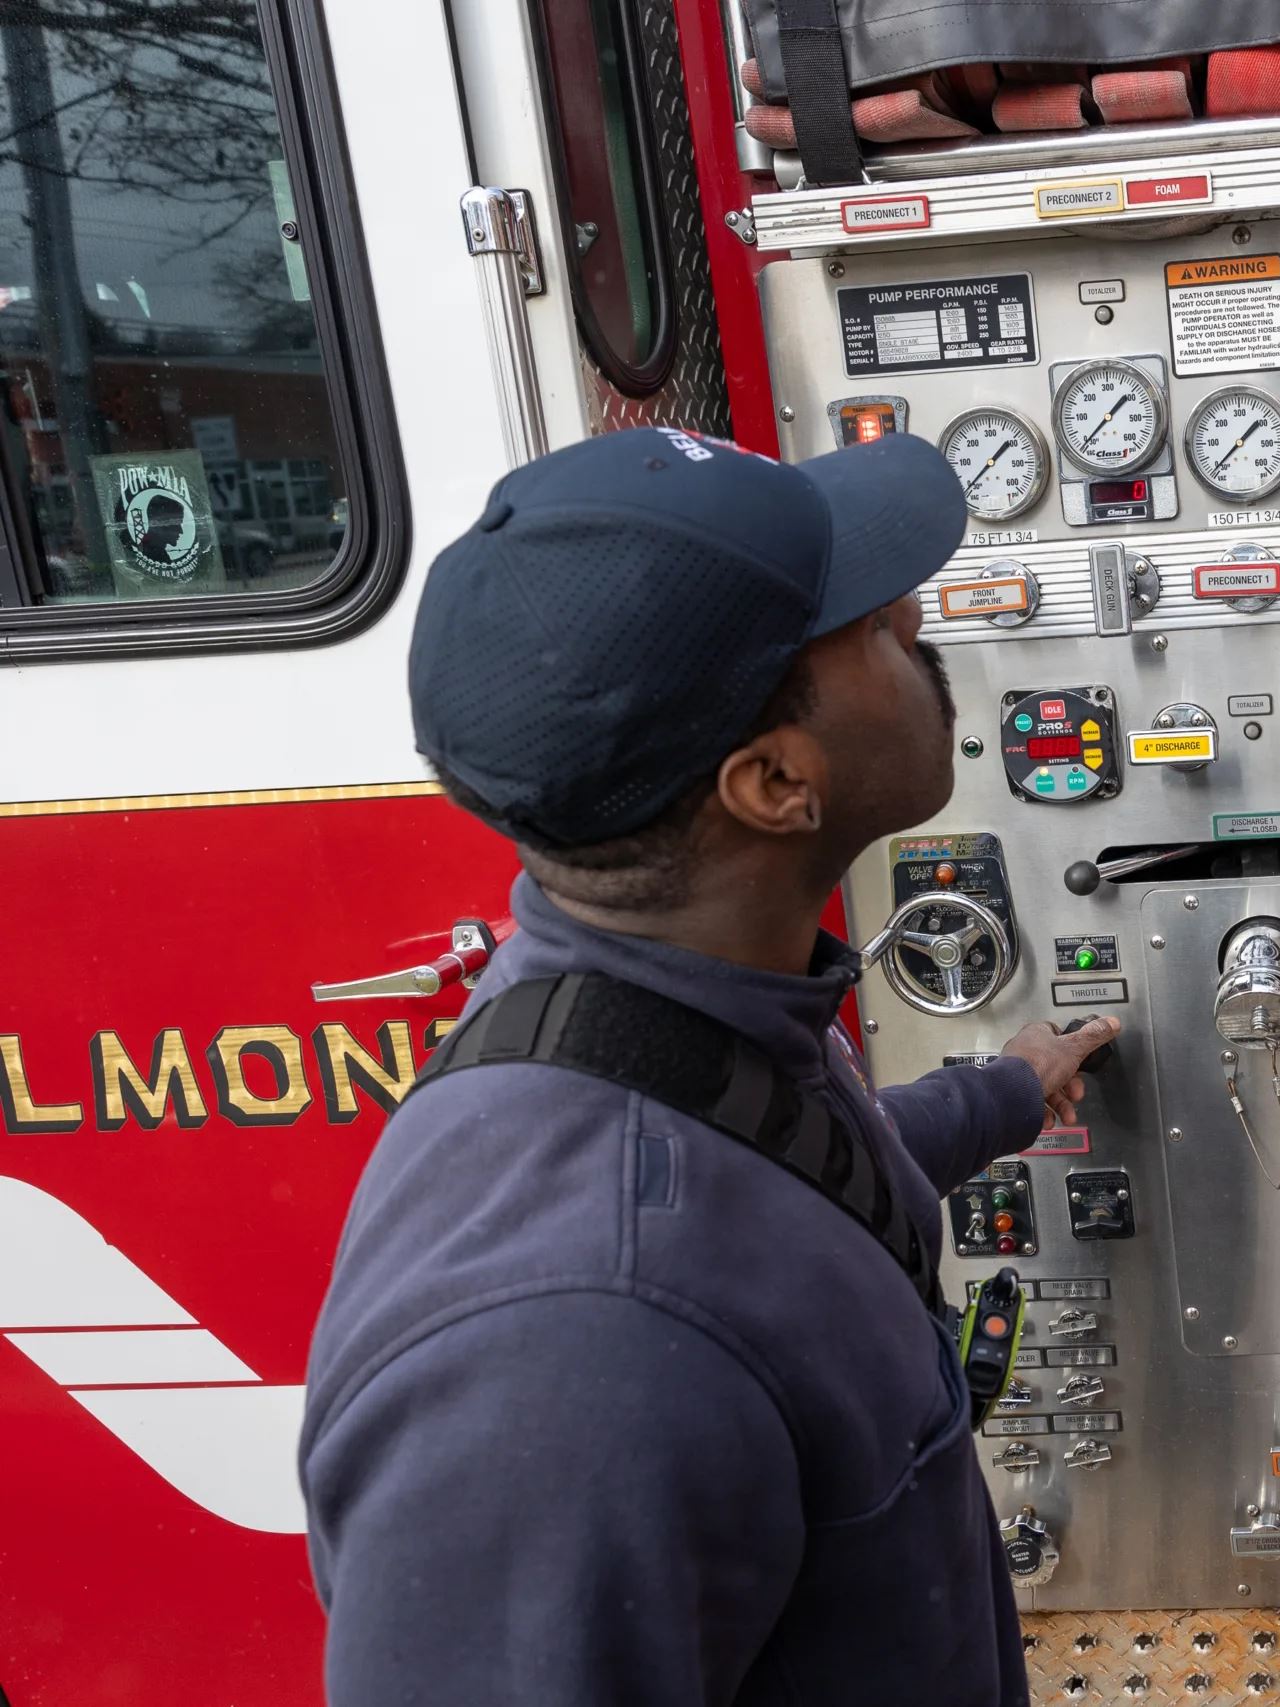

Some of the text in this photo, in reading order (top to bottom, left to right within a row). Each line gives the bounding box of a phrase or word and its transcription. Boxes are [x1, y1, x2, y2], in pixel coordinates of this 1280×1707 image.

[1155, 183, 1180, 196] FOAM
[1046, 191, 1112, 207] PRECONNECT 2
[854, 207, 917, 221] PRECONNECT 1
[1195, 262, 1267, 278] WARNING
[869, 283, 998, 303] PUMP PERFORMANCE
[1179, 292, 1202, 300] DEATH
[1216, 288, 1246, 297] SERIOUS
[1247, 286, 1272, 294] INJURY
[1172, 301, 1194, 309] MIGHT
[1228, 298, 1249, 306] proper
[1251, 294, 1280, 303] operating
[1174, 306, 1211, 318] procedures
[1237, 304, 1265, 312] followed.
[1203, 314, 1240, 323] OPERATOR
[1183, 319, 1273, 332] INDIVIDUALS CONNECTING
[1177, 333, 1202, 341] SUPPLY
[1217, 328, 1256, 338] DISCHARGE
[1180, 347, 1212, 356] FAMILIAR
[1248, 342, 1280, 352] hydraulics
[1208, 338, 1240, 350] apparatus
[1177, 356, 1201, 365] hazards
[1216, 354, 1250, 363] component
[1101, 383, 1114, 392] 300
[1233, 409, 1246, 418] 300
[984, 429, 997, 437] 300
[1133, 481, 1145, 498] 0
[1213, 515, 1233, 524] 150
[1237, 514, 1251, 523] FT
[1255, 513, 1259, 523] 1
[972, 532, 1033, 544] 75 FT 1 3/4
[1208, 575, 1270, 585] PRECONNECT 1
[973, 589, 995, 597] FRONT
[1104, 569, 1116, 611] DECK GUN
[968, 597, 1003, 607] JUMPLINE
[1044, 706, 1061, 714] IDLE
[1236, 701, 1264, 709] TOTALIZER
[1144, 741, 1200, 752] 4" DISCHARGE
[1231, 818, 1266, 826] DISCHARGE
[1252, 825, 1277, 833] CLOSED
[908, 866, 933, 874] VALVE
[1090, 936, 1114, 944] DANGER
[1071, 988, 1108, 997] THROTTLE
[956, 1056, 988, 1066] PRIME
[0, 1020, 458, 1135] LMON
